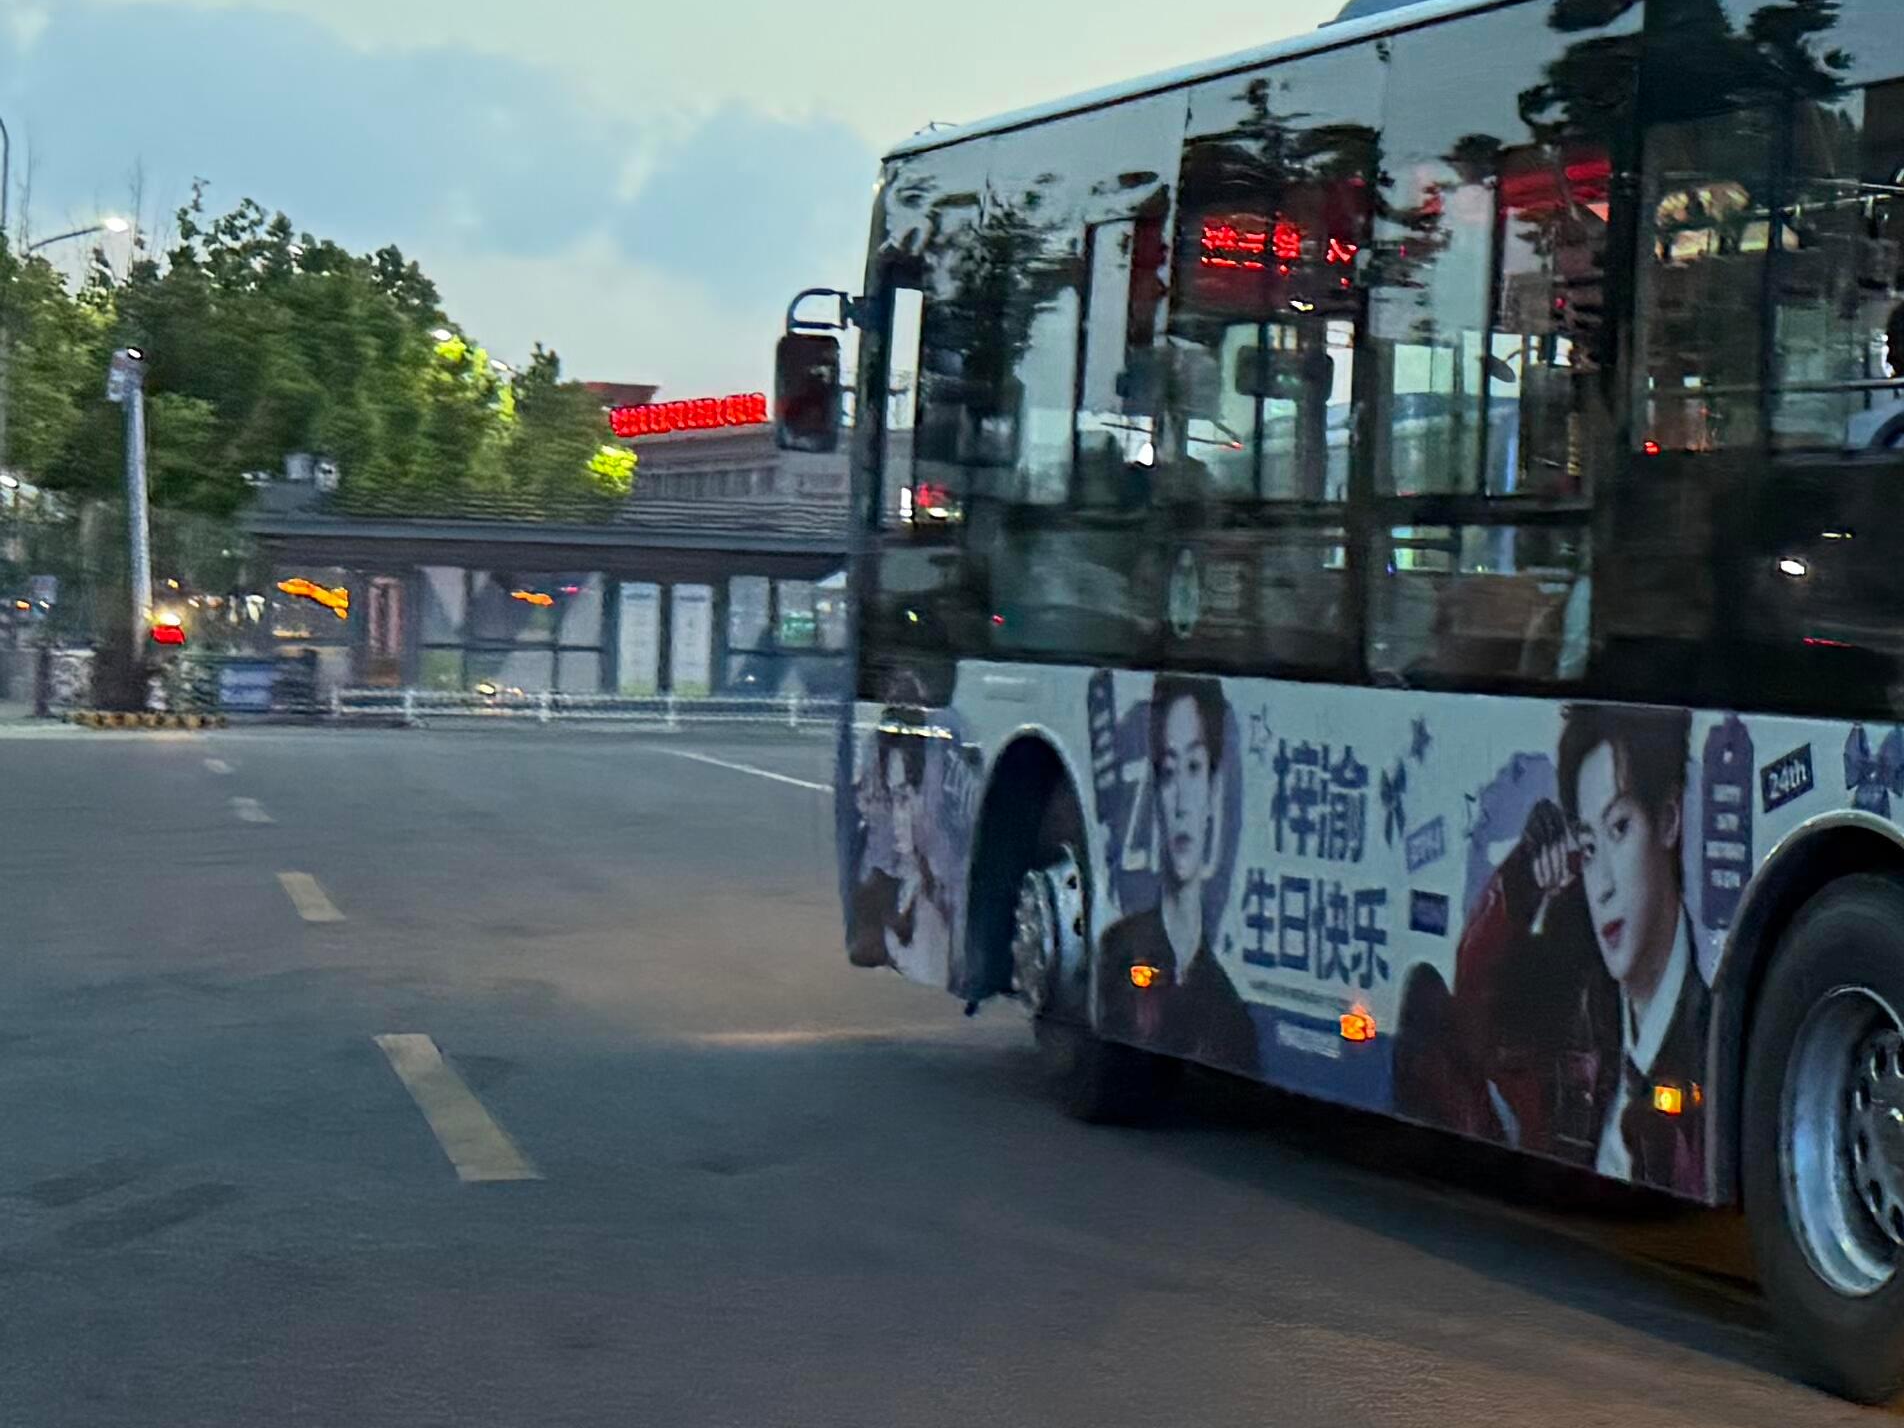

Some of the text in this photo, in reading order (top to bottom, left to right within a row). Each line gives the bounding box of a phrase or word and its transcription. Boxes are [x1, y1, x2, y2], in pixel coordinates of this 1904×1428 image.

[1269, 737, 1369, 863] 梓渝
[1242, 867, 1390, 990] 生日快乐
